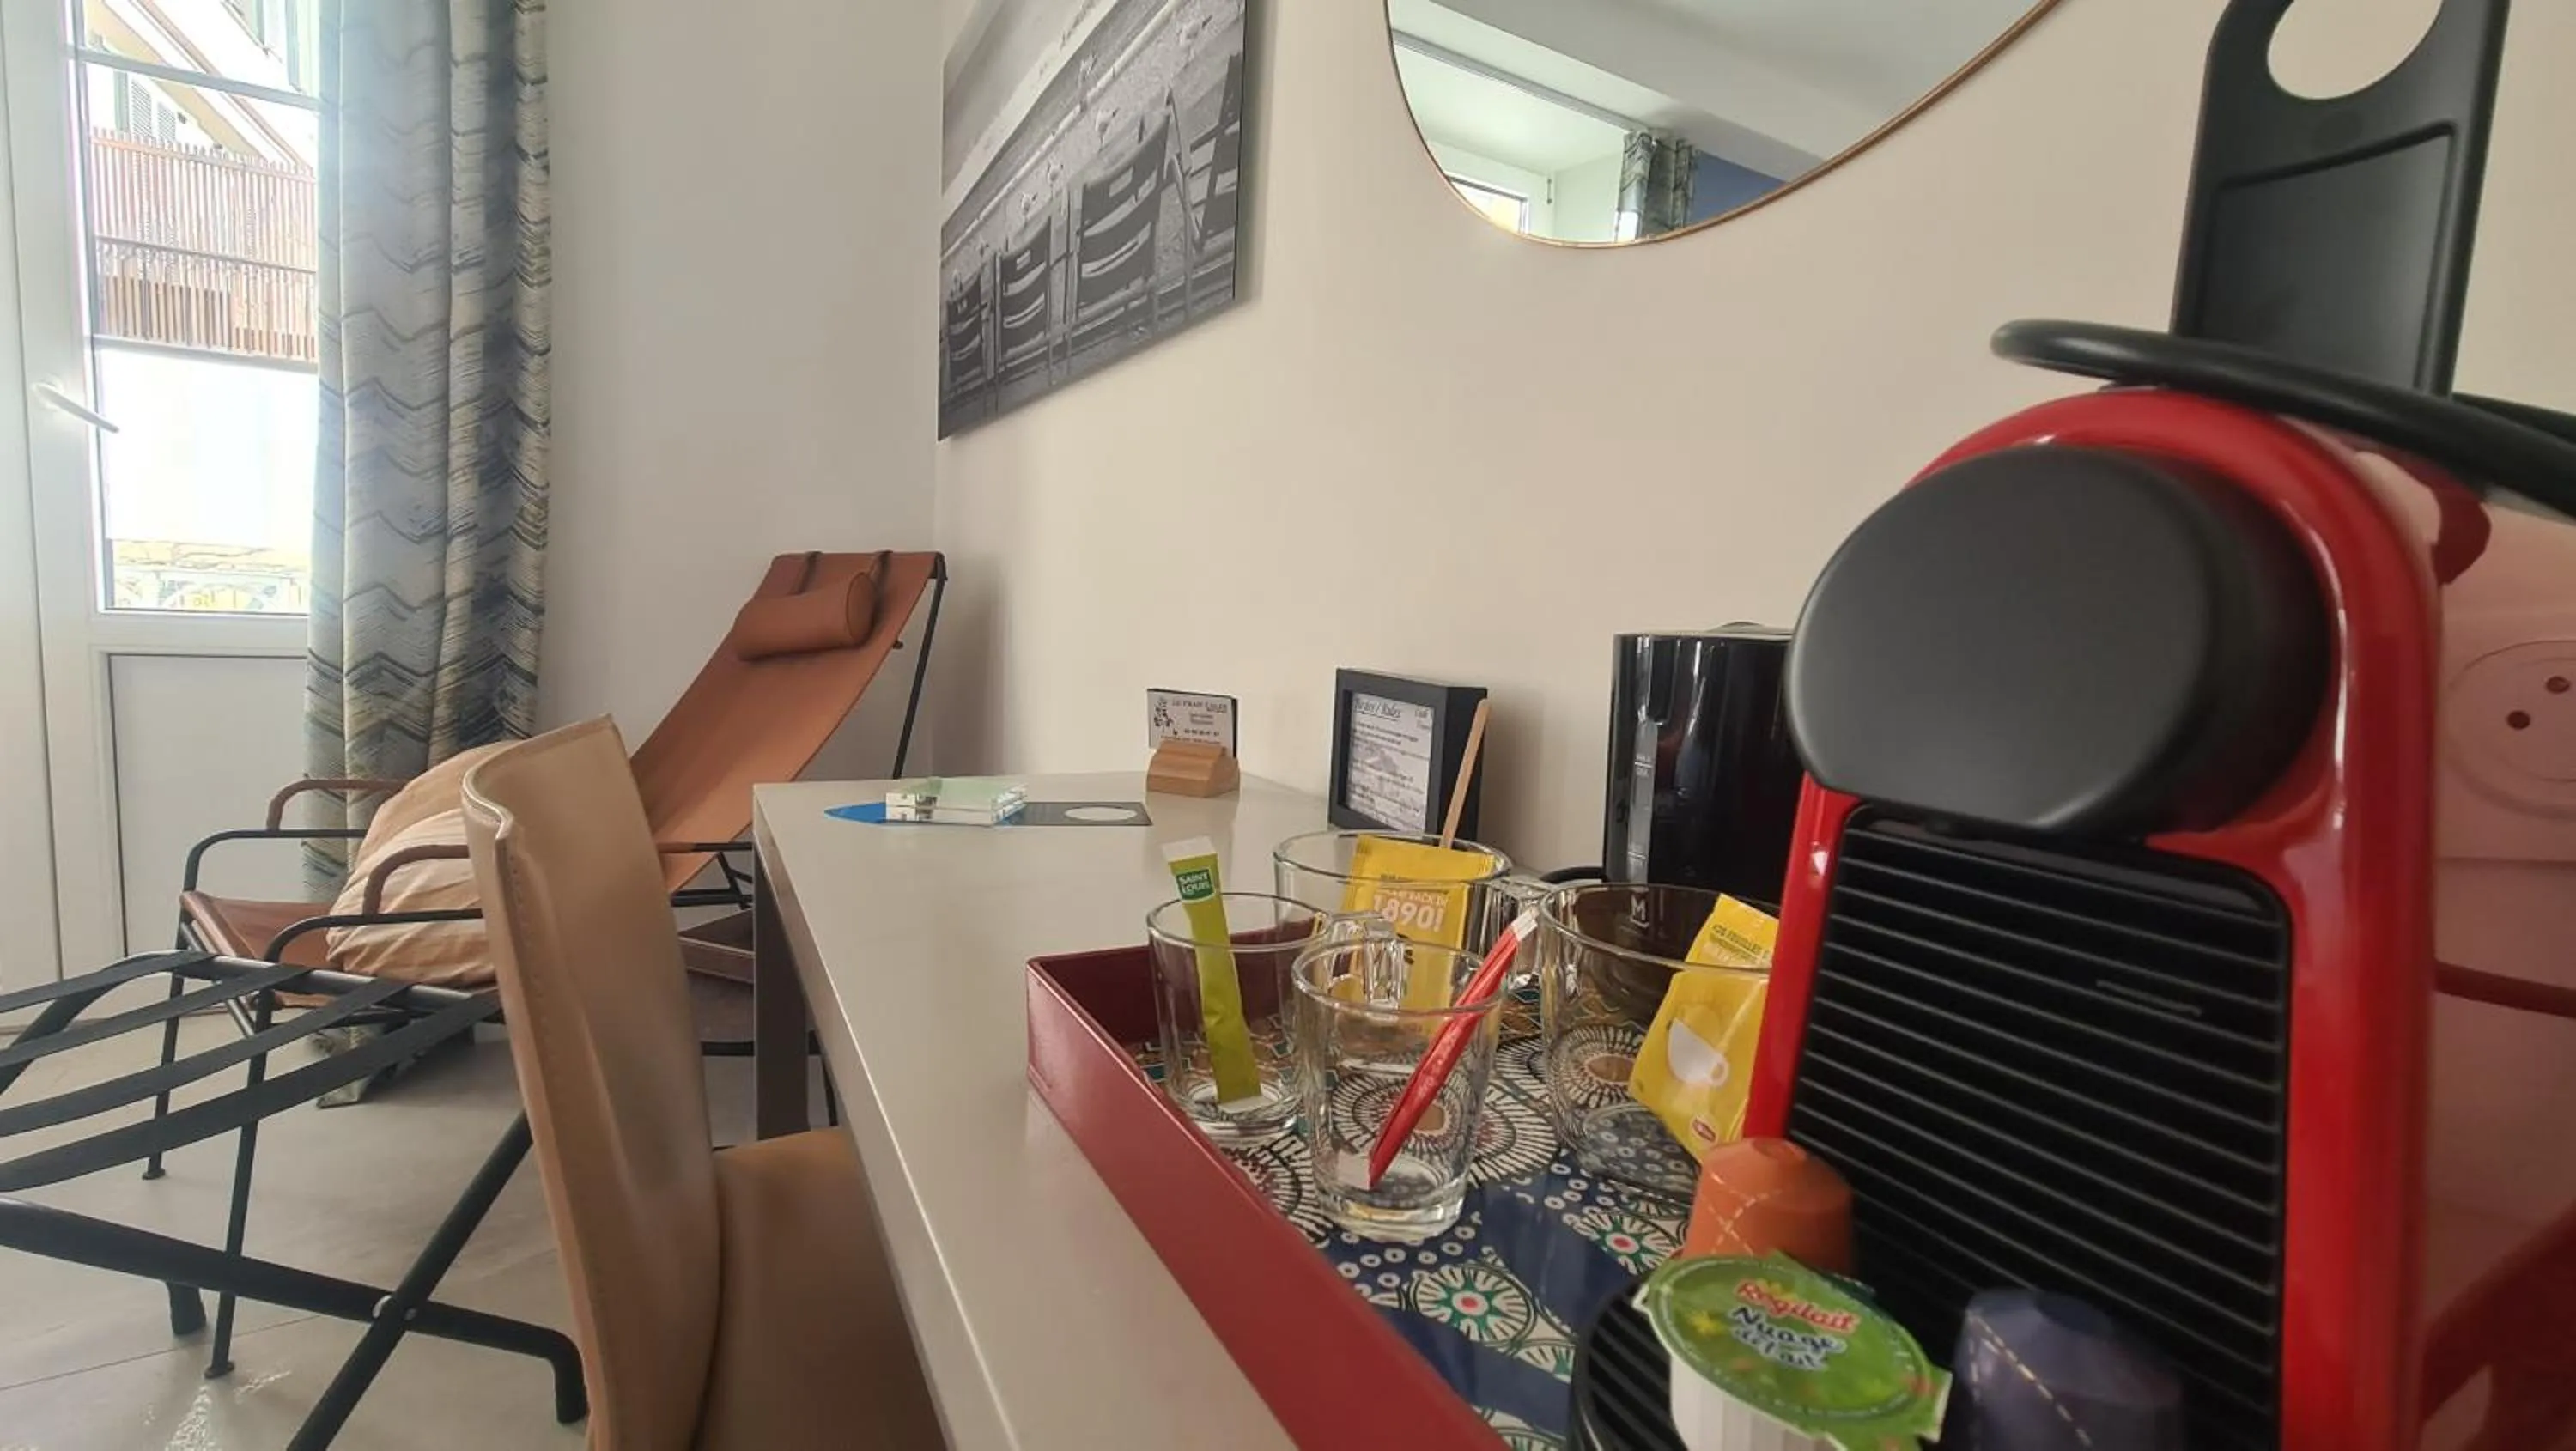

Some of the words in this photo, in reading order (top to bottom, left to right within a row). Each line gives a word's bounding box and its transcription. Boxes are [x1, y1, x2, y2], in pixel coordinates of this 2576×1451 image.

[1178, 871, 1209, 884] SAINT
[1181, 880, 1211, 895] LOUIS
[1373, 894, 1445, 933] 1890!
